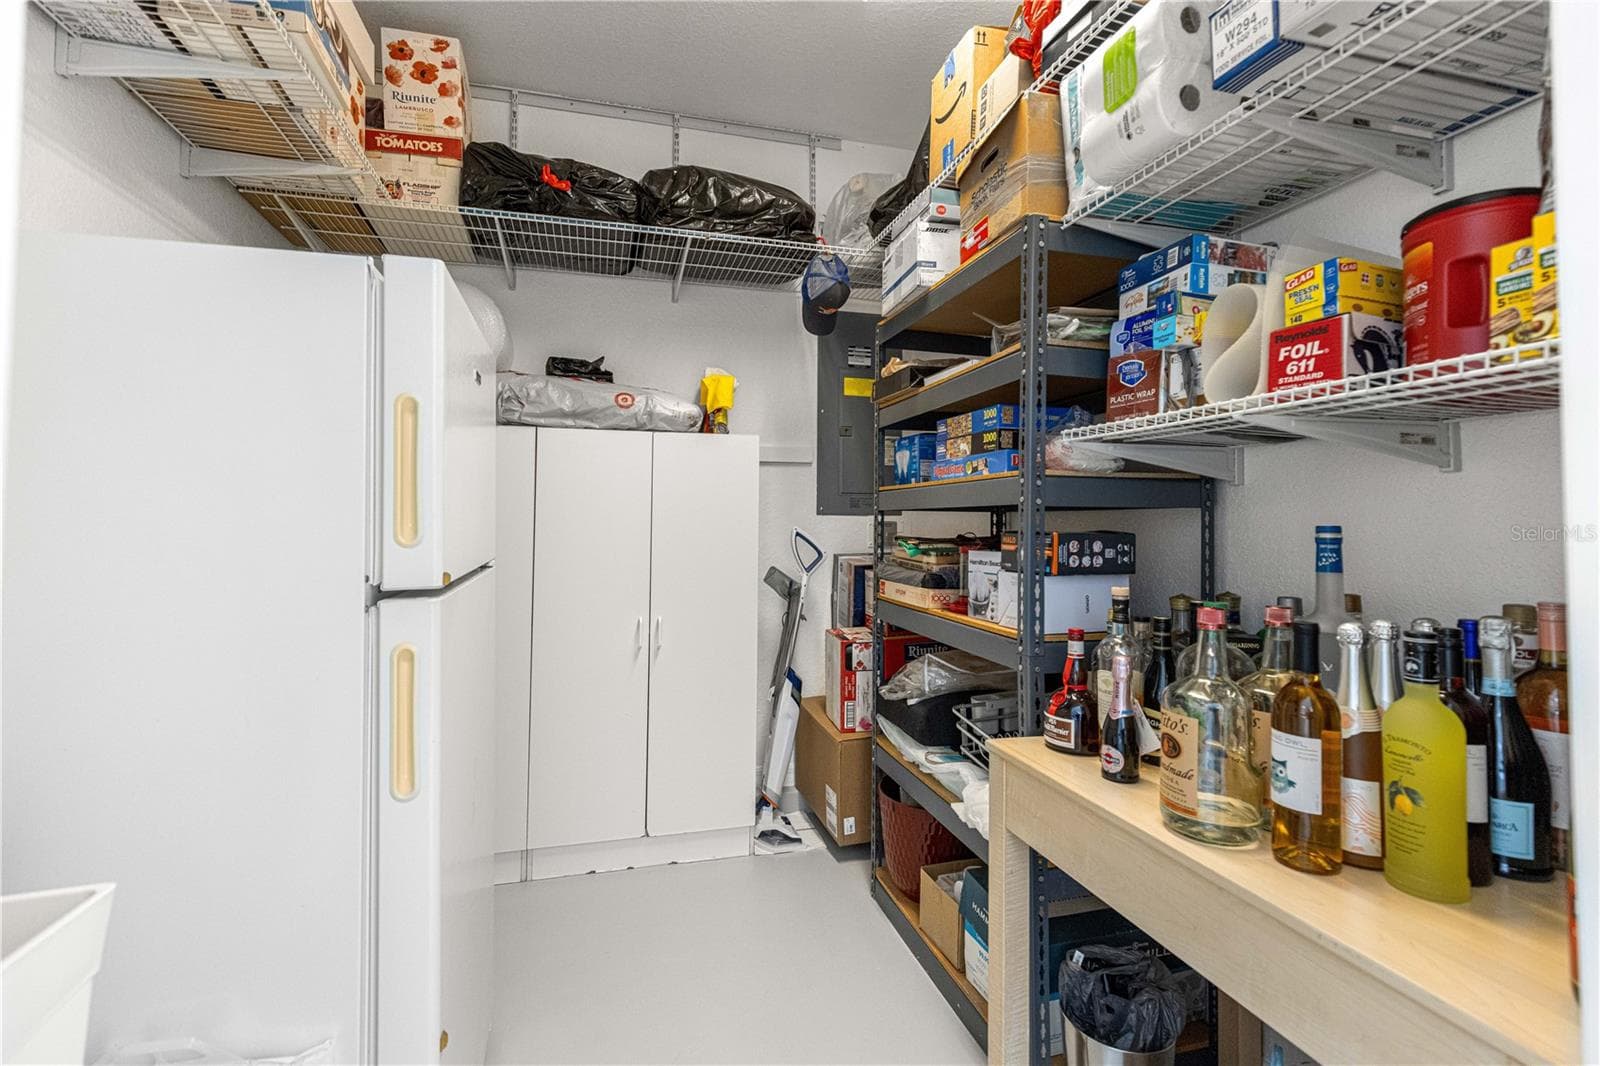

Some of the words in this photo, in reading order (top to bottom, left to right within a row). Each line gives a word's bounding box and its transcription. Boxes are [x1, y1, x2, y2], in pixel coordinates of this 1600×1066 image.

[1225, 12, 1257, 43] W294
[392, 90, 436, 105] Riunite
[395, 104, 434, 113] LAMBRUSCO
[374, 136, 444, 152] TOMATOES
[1286, 269, 1314, 289] GLAD
[1294, 295, 1314, 305] SEAL
[1497, 298, 1506, 308] 5
[1290, 314, 1303, 324] 140
[1275, 325, 1330, 344] Reynolds
[1278, 340, 1323, 361] FOIL
[1286, 357, 1315, 375] 611
[1278, 371, 1324, 384] STANDARD
[1110, 394, 1134, 404] PLASTIC
[1136, 388, 1156, 398] WRAP
[983, 408, 997, 419] 1000
[983, 431, 997, 442] 1000
